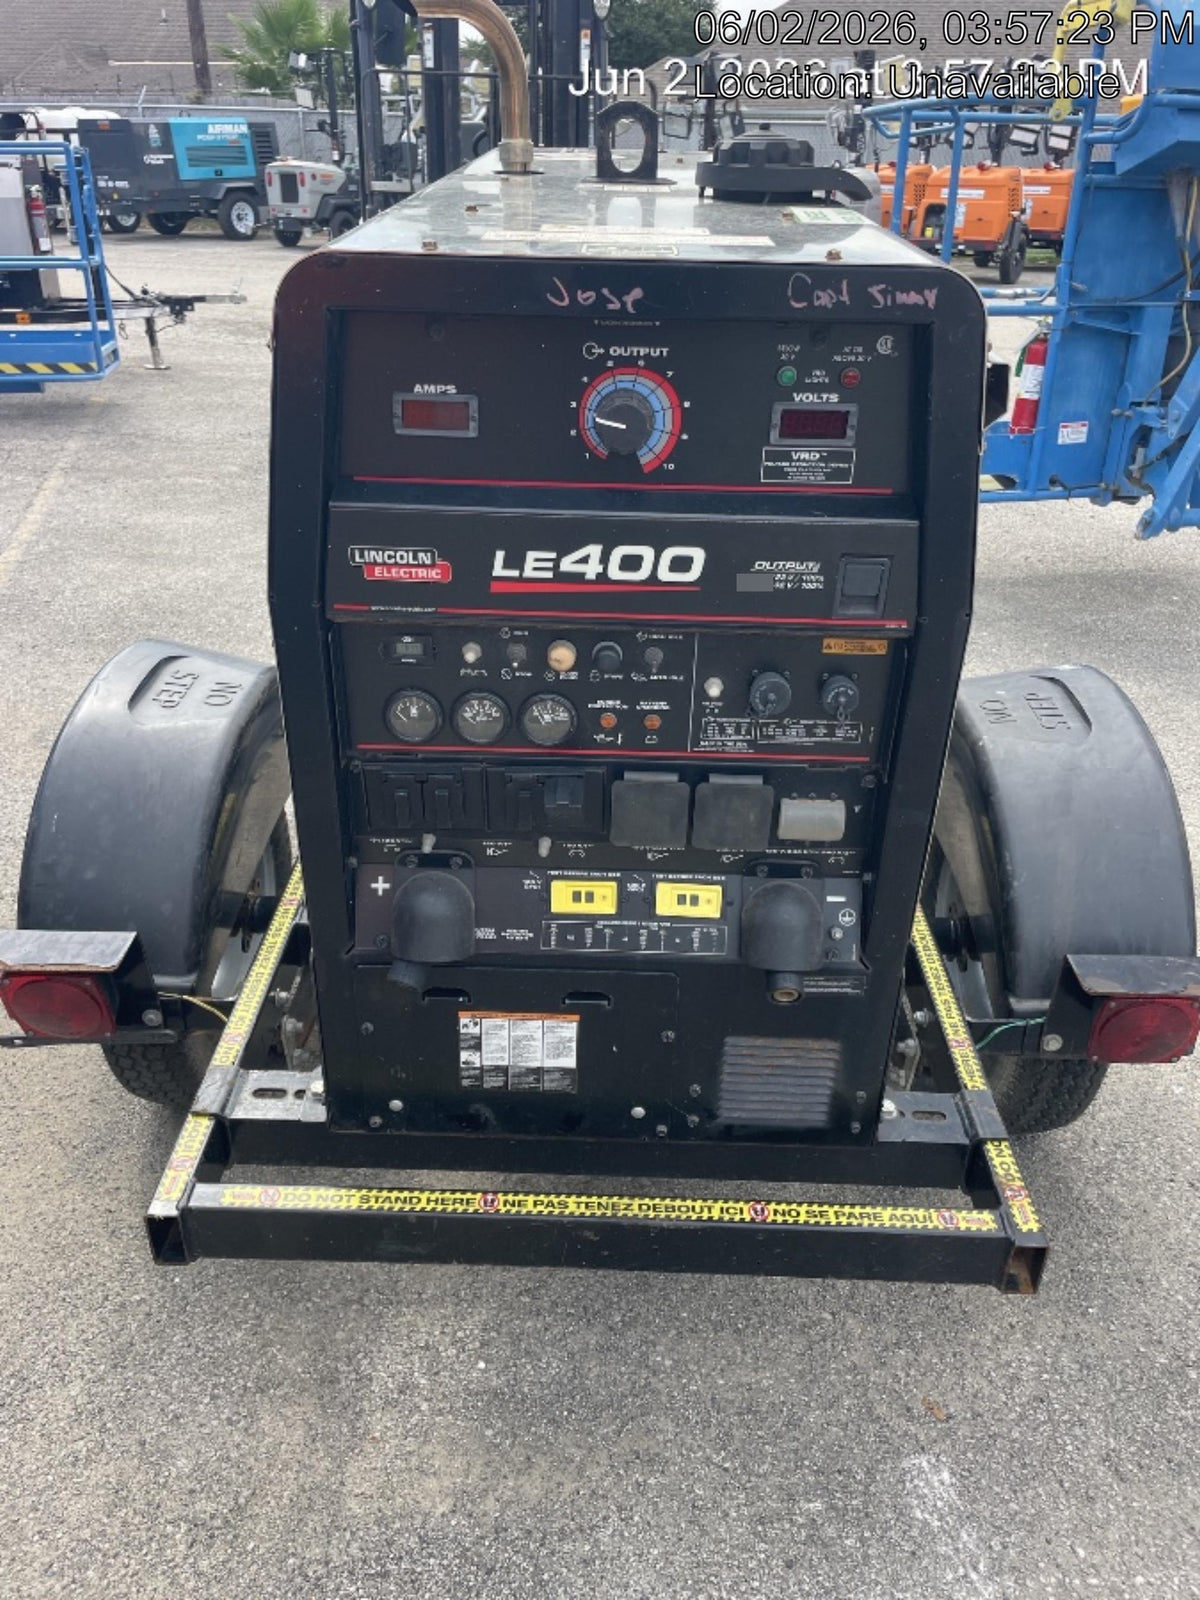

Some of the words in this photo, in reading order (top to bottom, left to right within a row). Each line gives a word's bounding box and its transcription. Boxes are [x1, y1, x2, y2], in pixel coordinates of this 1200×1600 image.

[609, 345, 670, 358] OUTPUT
[413, 383, 457, 394] AMPS
[792, 393, 840, 403] VOLTS
[354, 549, 432, 564] LINCOLN
[492, 544, 706, 582] LE400
[374, 567, 442, 579] ELECTRIC
[152, 670, 200, 708] STEP
[1024, 692, 1071, 730] STEP
[284, 1192, 313, 1205] DO
[315, 1193, 357, 1205] NOT
[359, 1194, 422, 1207] STAND
[426, 1195, 477, 1208] HERE
[502, 1198, 529, 1209] NE
[533, 1198, 569, 1210] PAS
[574, 1200, 633, 1213] TENEZ
[638, 1202, 713, 1216] DEBOUT
[719, 1205, 744, 1217] ICI
[773, 1207, 800, 1219] NO
[805, 1209, 830, 1221] SE
[835, 1210, 884, 1222] PARE
